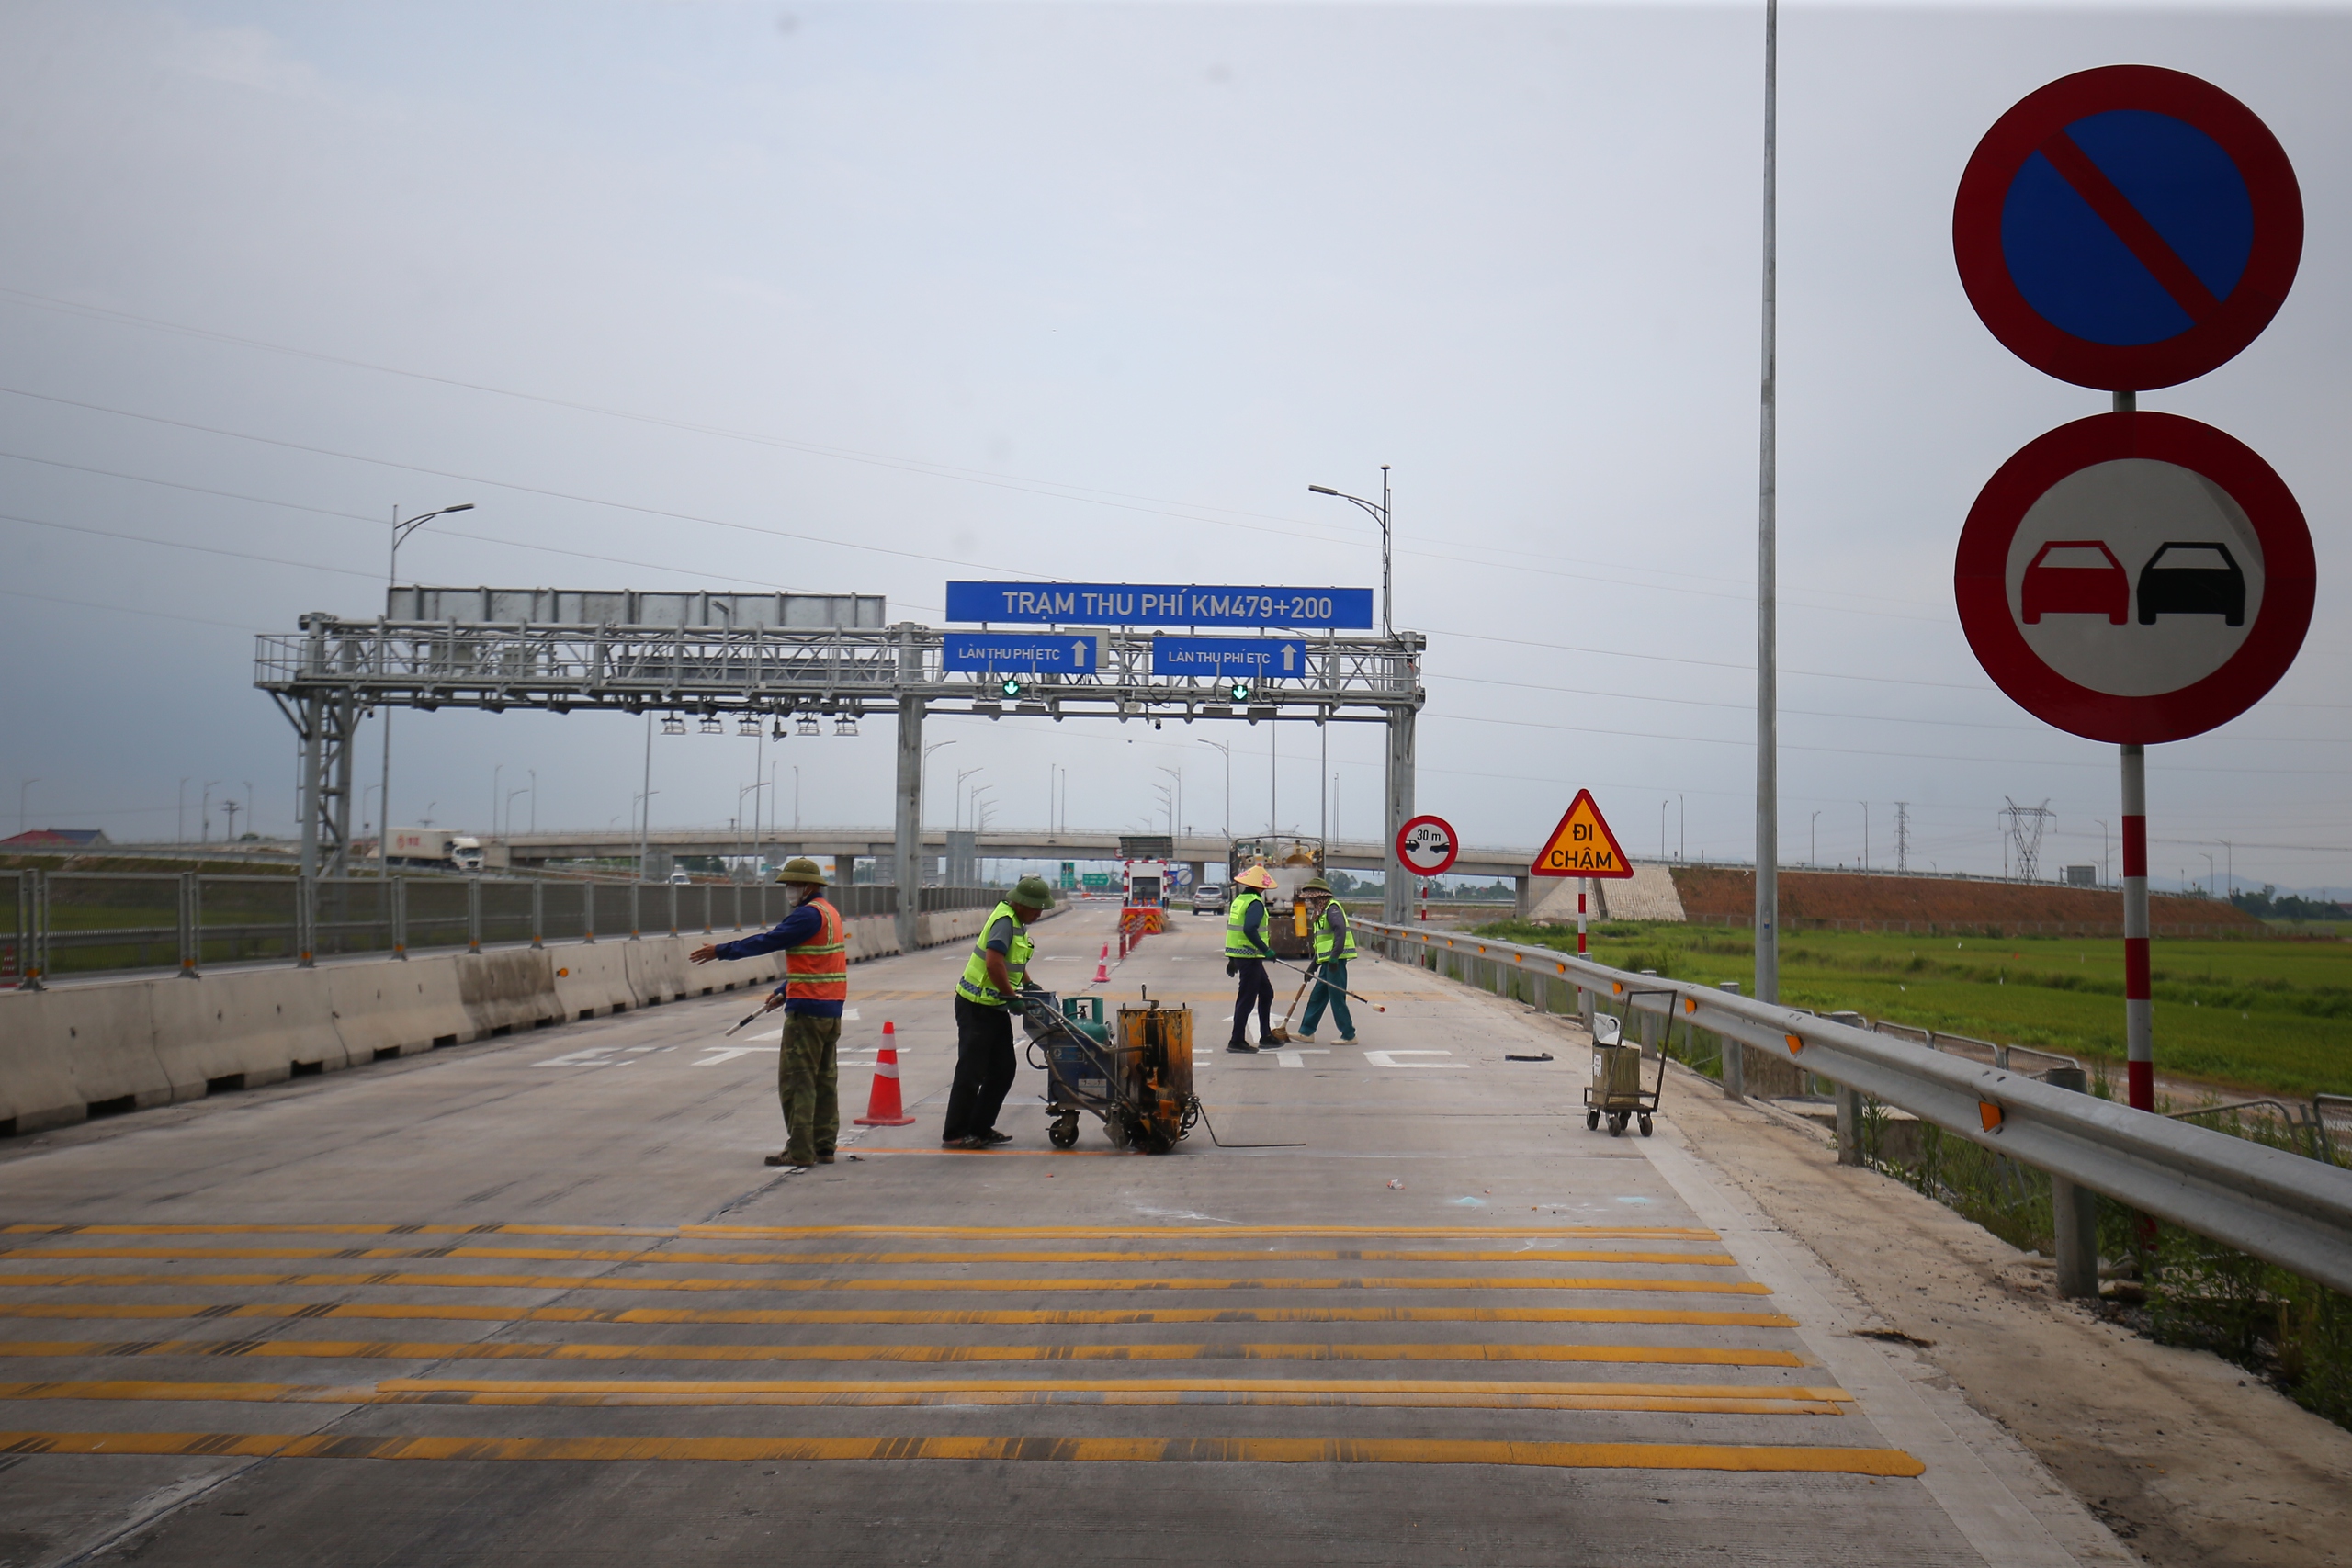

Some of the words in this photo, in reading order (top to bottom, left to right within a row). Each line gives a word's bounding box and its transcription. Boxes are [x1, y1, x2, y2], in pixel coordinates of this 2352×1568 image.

[1002, 592, 1076, 620] TRẠM
[1082, 592, 1134, 615] THU
[1141, 588, 1188, 616] PHÍ
[1193, 595, 1332, 619] KM479+200
[958, 644, 985, 659] LÀN
[987, 648, 1012, 660] THU
[1013, 645, 1036, 660] PHÍ
[1036, 649, 1060, 660] ETC
[1168, 647, 1194, 662] LÀN
[1196, 651, 1221, 663] THU
[1224, 649, 1246, 663] PHÍ
[1247, 653, 1271, 664] ETC
[1417, 829, 1430, 842] 30
[1431, 831, 1442, 842] m
[1572, 824, 1593, 841] ĐI
[1550, 847, 1612, 872] CHẬM
